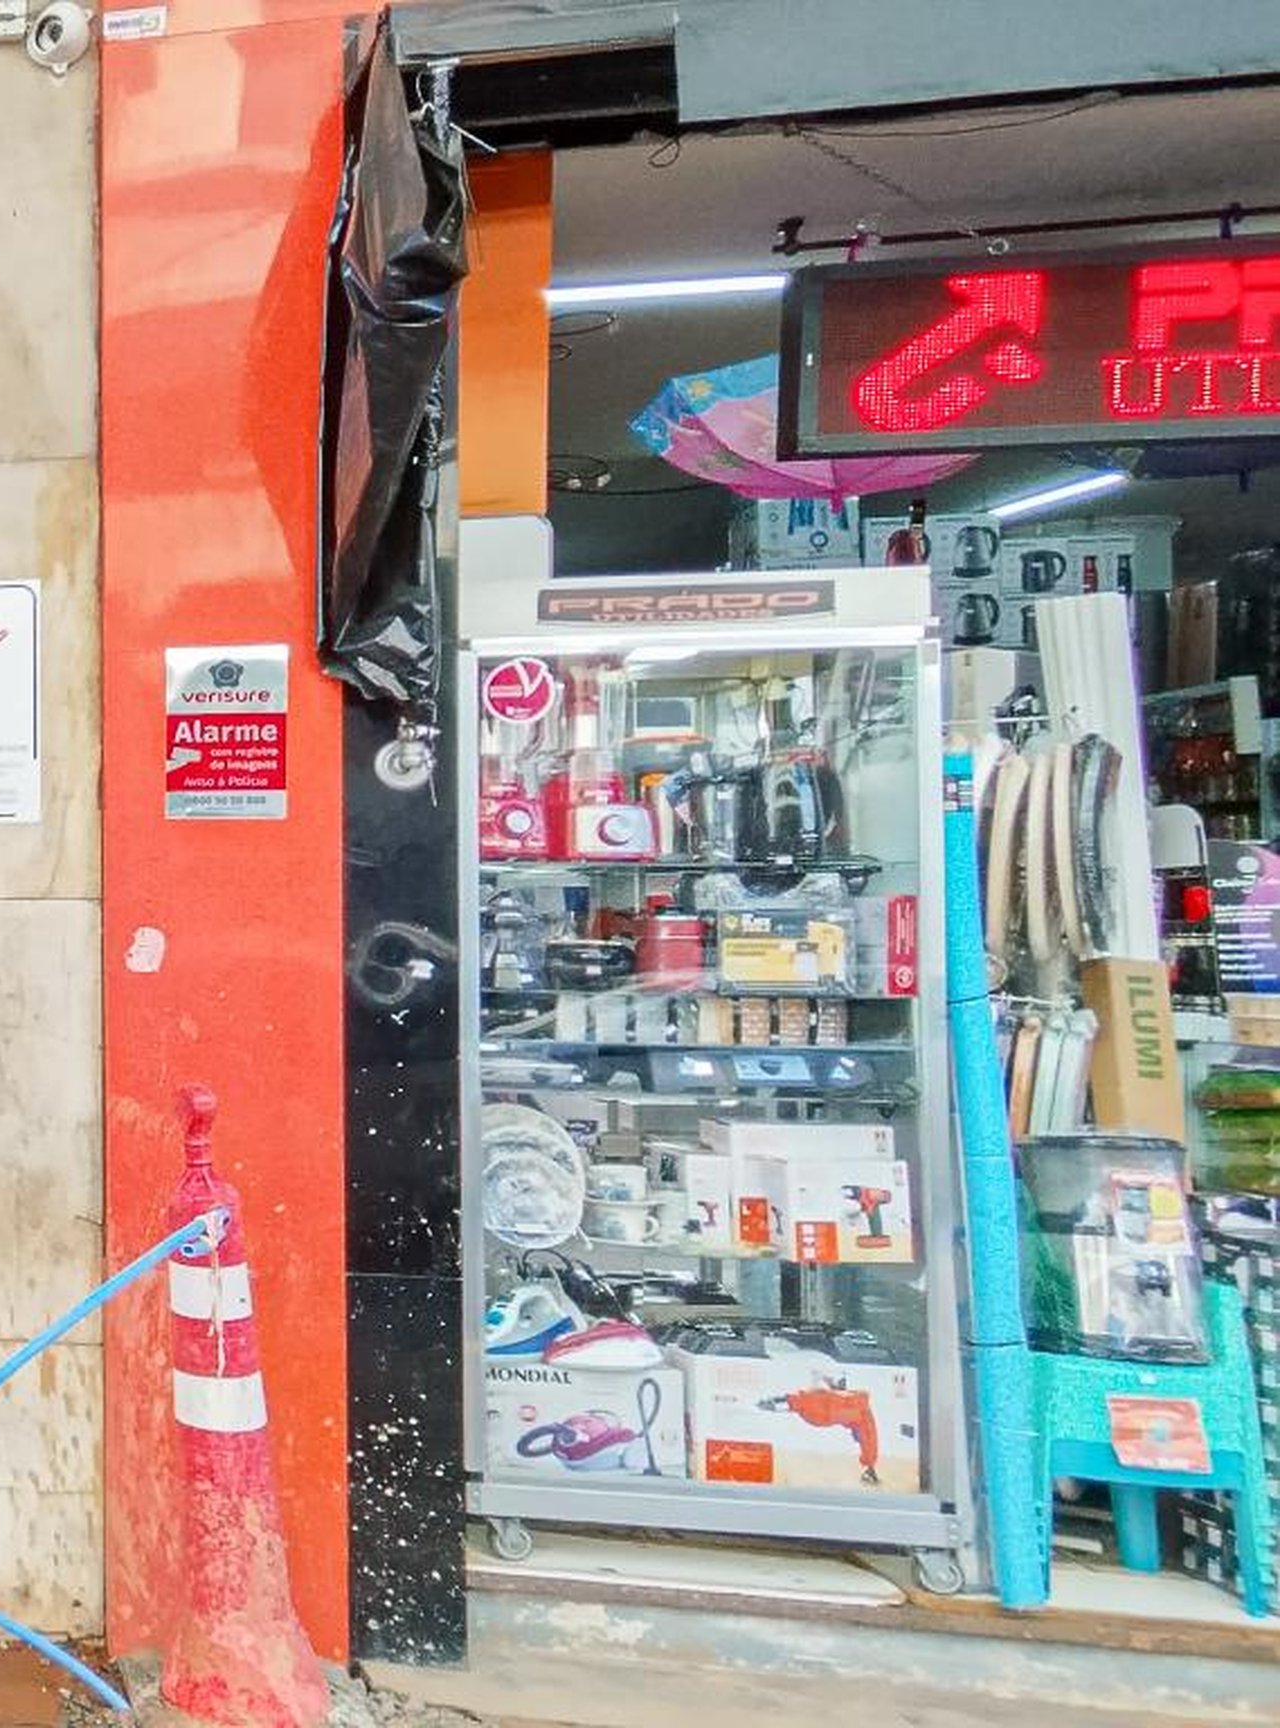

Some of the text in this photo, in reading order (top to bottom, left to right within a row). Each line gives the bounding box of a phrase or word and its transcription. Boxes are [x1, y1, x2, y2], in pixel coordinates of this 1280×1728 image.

[548, 590, 820, 613] PRADO
[181, 690, 271, 703] verisure
[174, 720, 278, 743] Alarme
[1126, 975, 1164, 1080] ILUMI
